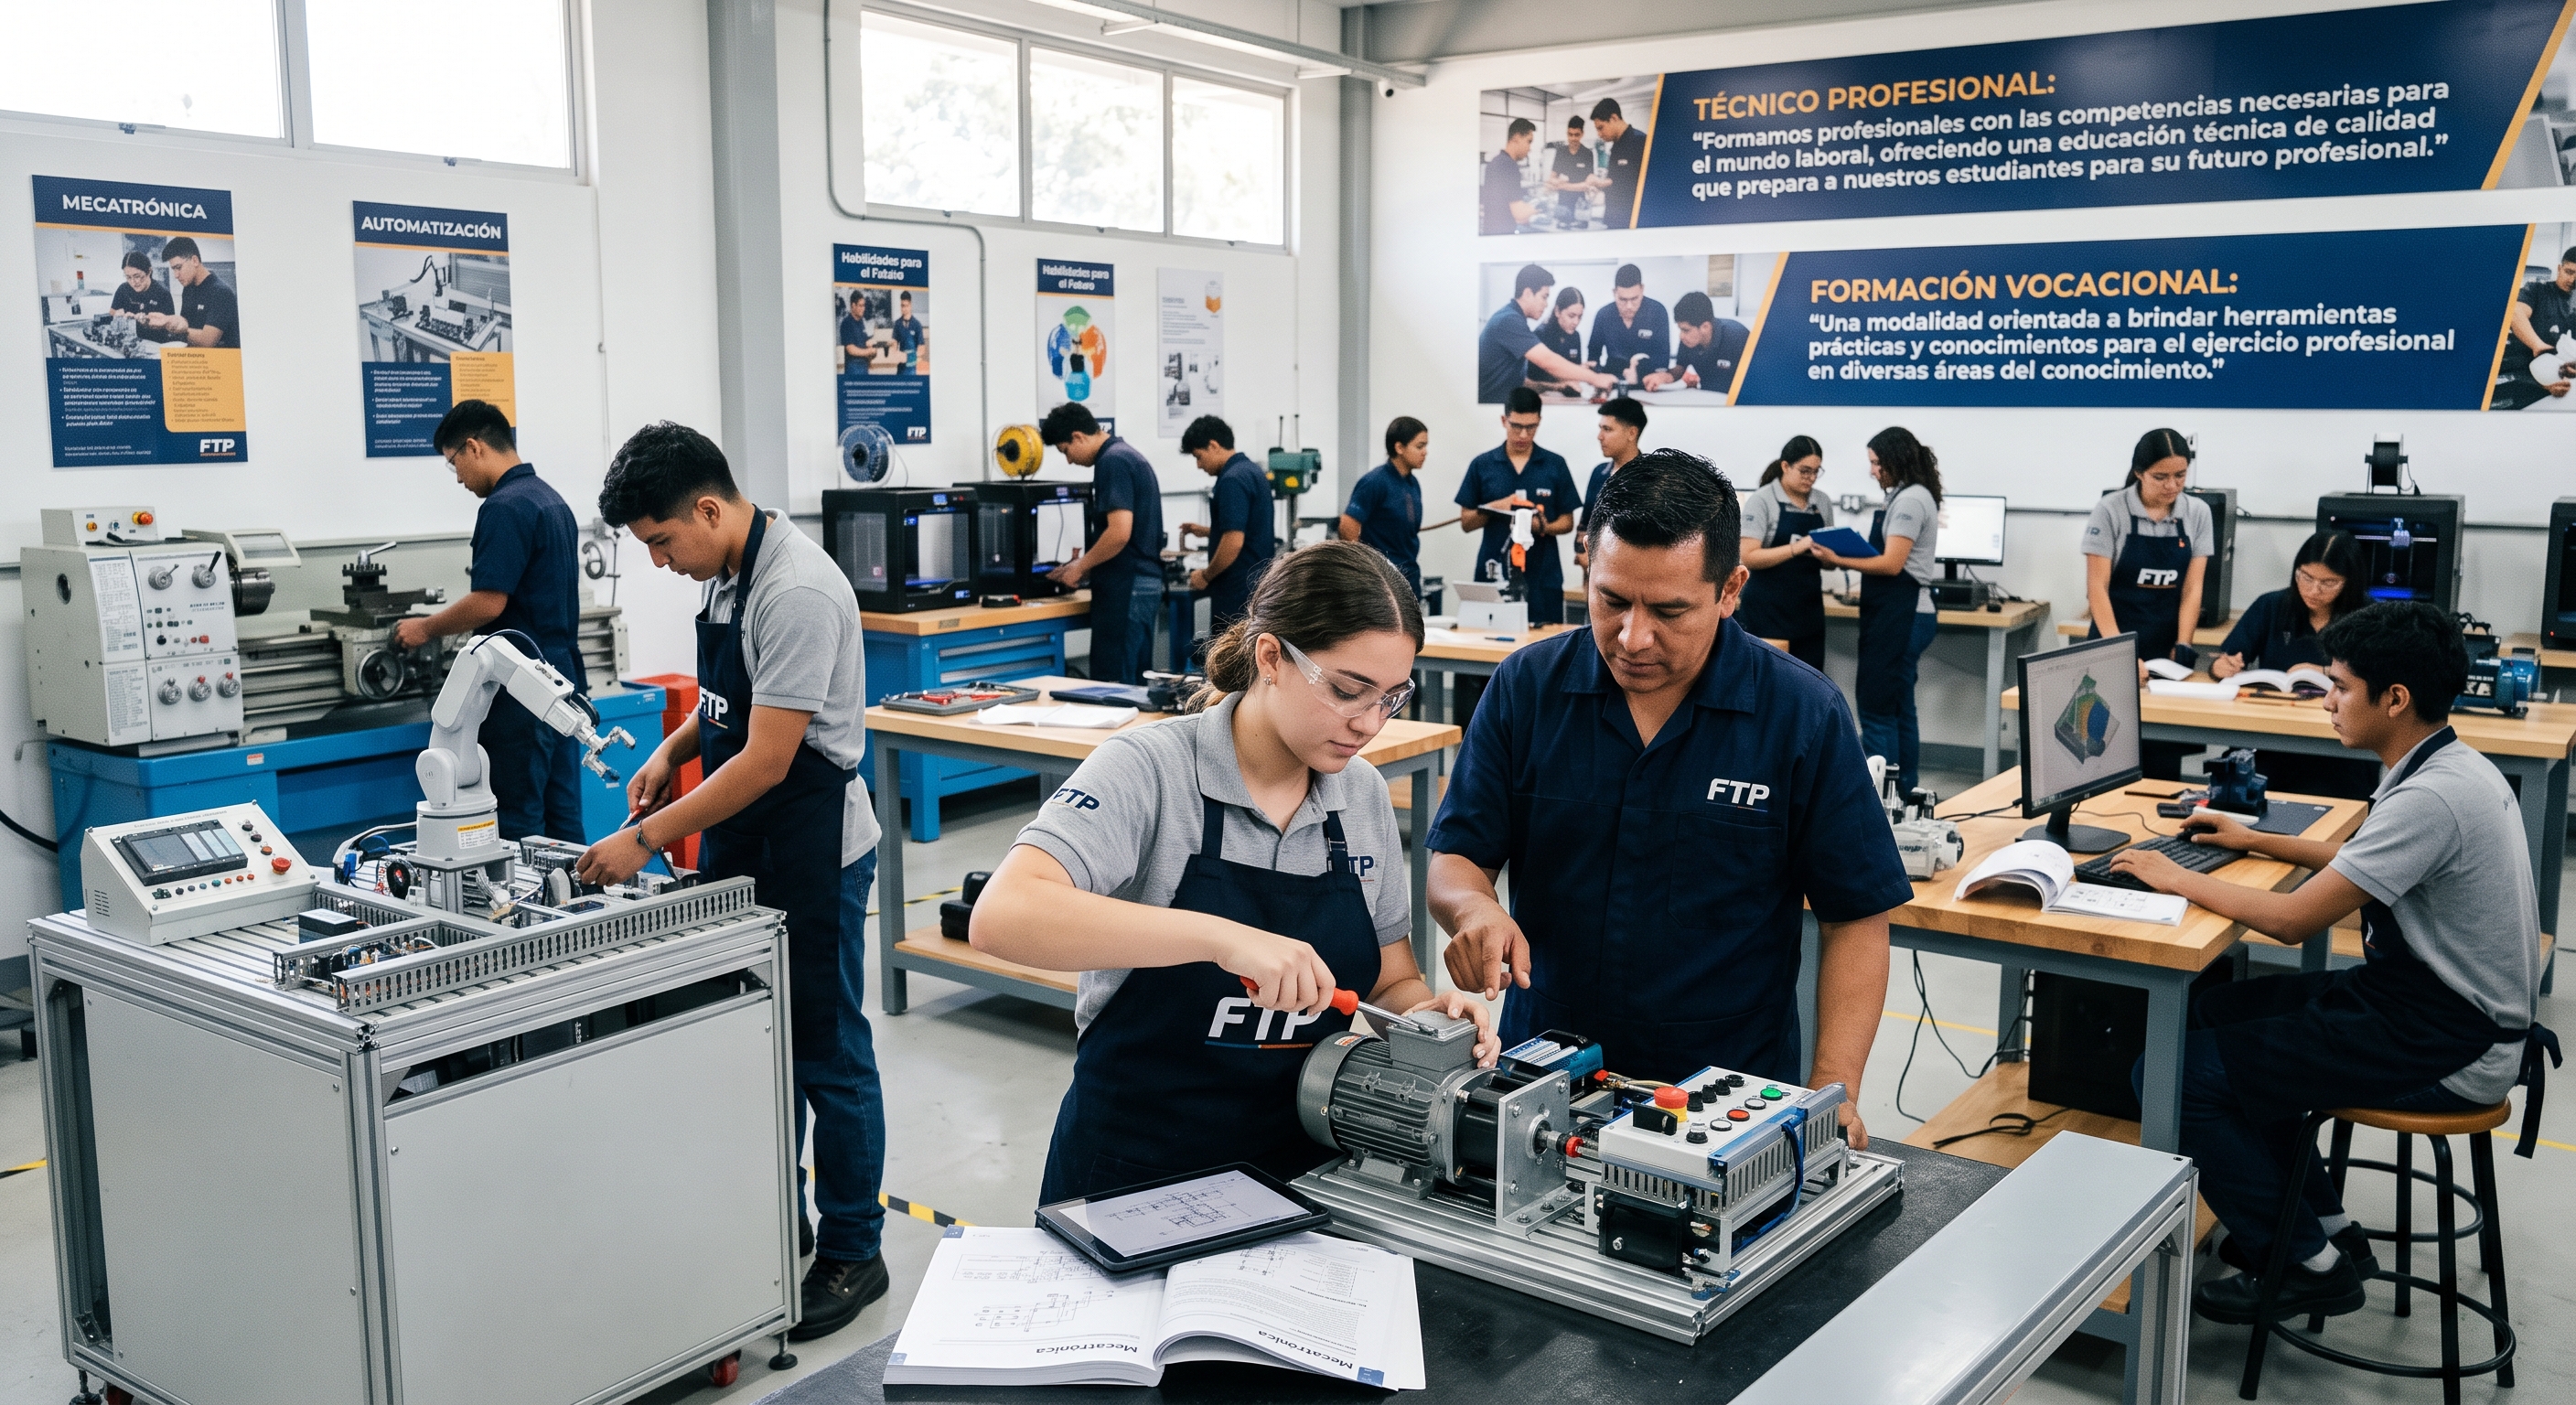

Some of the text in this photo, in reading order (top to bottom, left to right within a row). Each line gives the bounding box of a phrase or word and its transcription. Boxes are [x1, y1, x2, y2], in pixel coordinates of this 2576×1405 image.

[1693, 71, 2056, 121] TÉCNICO PROFESIONAL:
[1692, 81, 2450, 150] “Formamos profesionales con las competencias necesarias para
[1691, 105, 2436, 175] el mundo laboral, ofreciendo una educación técnica de calidad
[1691, 133, 2449, 201] que prepara a nuestros estudiantes para su futuro profesional.”
[62, 194, 208, 220] MECATRÓNICA
[361, 216, 502, 241] AUTOMATIZACIÓN
[842, 252, 922, 269] Habilidades para
[861, 267, 869, 278] el
[1810, 268, 2238, 304] FORMACIÓN VOCACIONAL:
[1809, 303, 2397, 333] “Una modalidad orientada a brindar herramientas
[1809, 328, 2455, 360] prácticas y conocimientos para el ejercicio profesional
[1808, 358, 2225, 381] en diversas áreas del conocimiento.”
[907, 426, 927, 437] FTP
[200, 439, 235, 453] FTP
[2137, 568, 2178, 585] FTP
[698, 685, 729, 720] FTP
[1053, 788, 1100, 811] FTP
[1707, 778, 1770, 806] FTP
[1036, 1343, 1138, 1354] Mecatrónica
[1258, 1330, 1353, 1369] Mecatrónica
